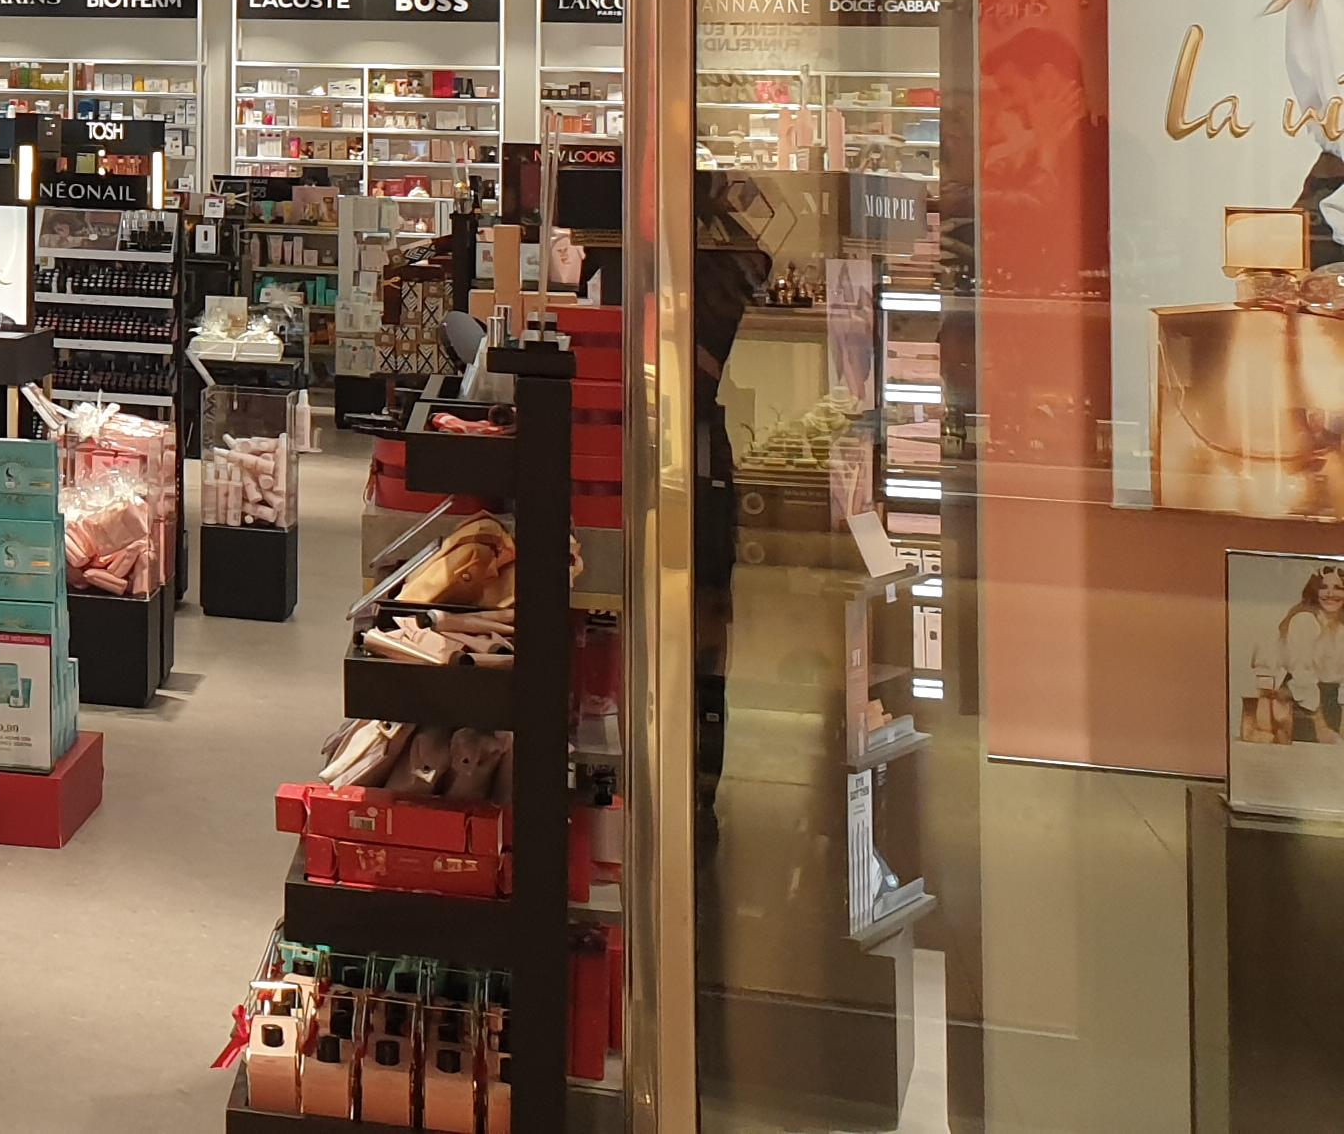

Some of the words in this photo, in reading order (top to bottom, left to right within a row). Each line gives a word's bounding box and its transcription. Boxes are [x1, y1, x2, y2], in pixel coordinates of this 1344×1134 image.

[1165, 23, 1255, 141] La
[86, 122, 124, 140] TOSH
[568, 150, 616, 163] LOOKS
[39, 180, 137, 202] NÉONAIL
[864, 194, 915, 221] MORPHE
